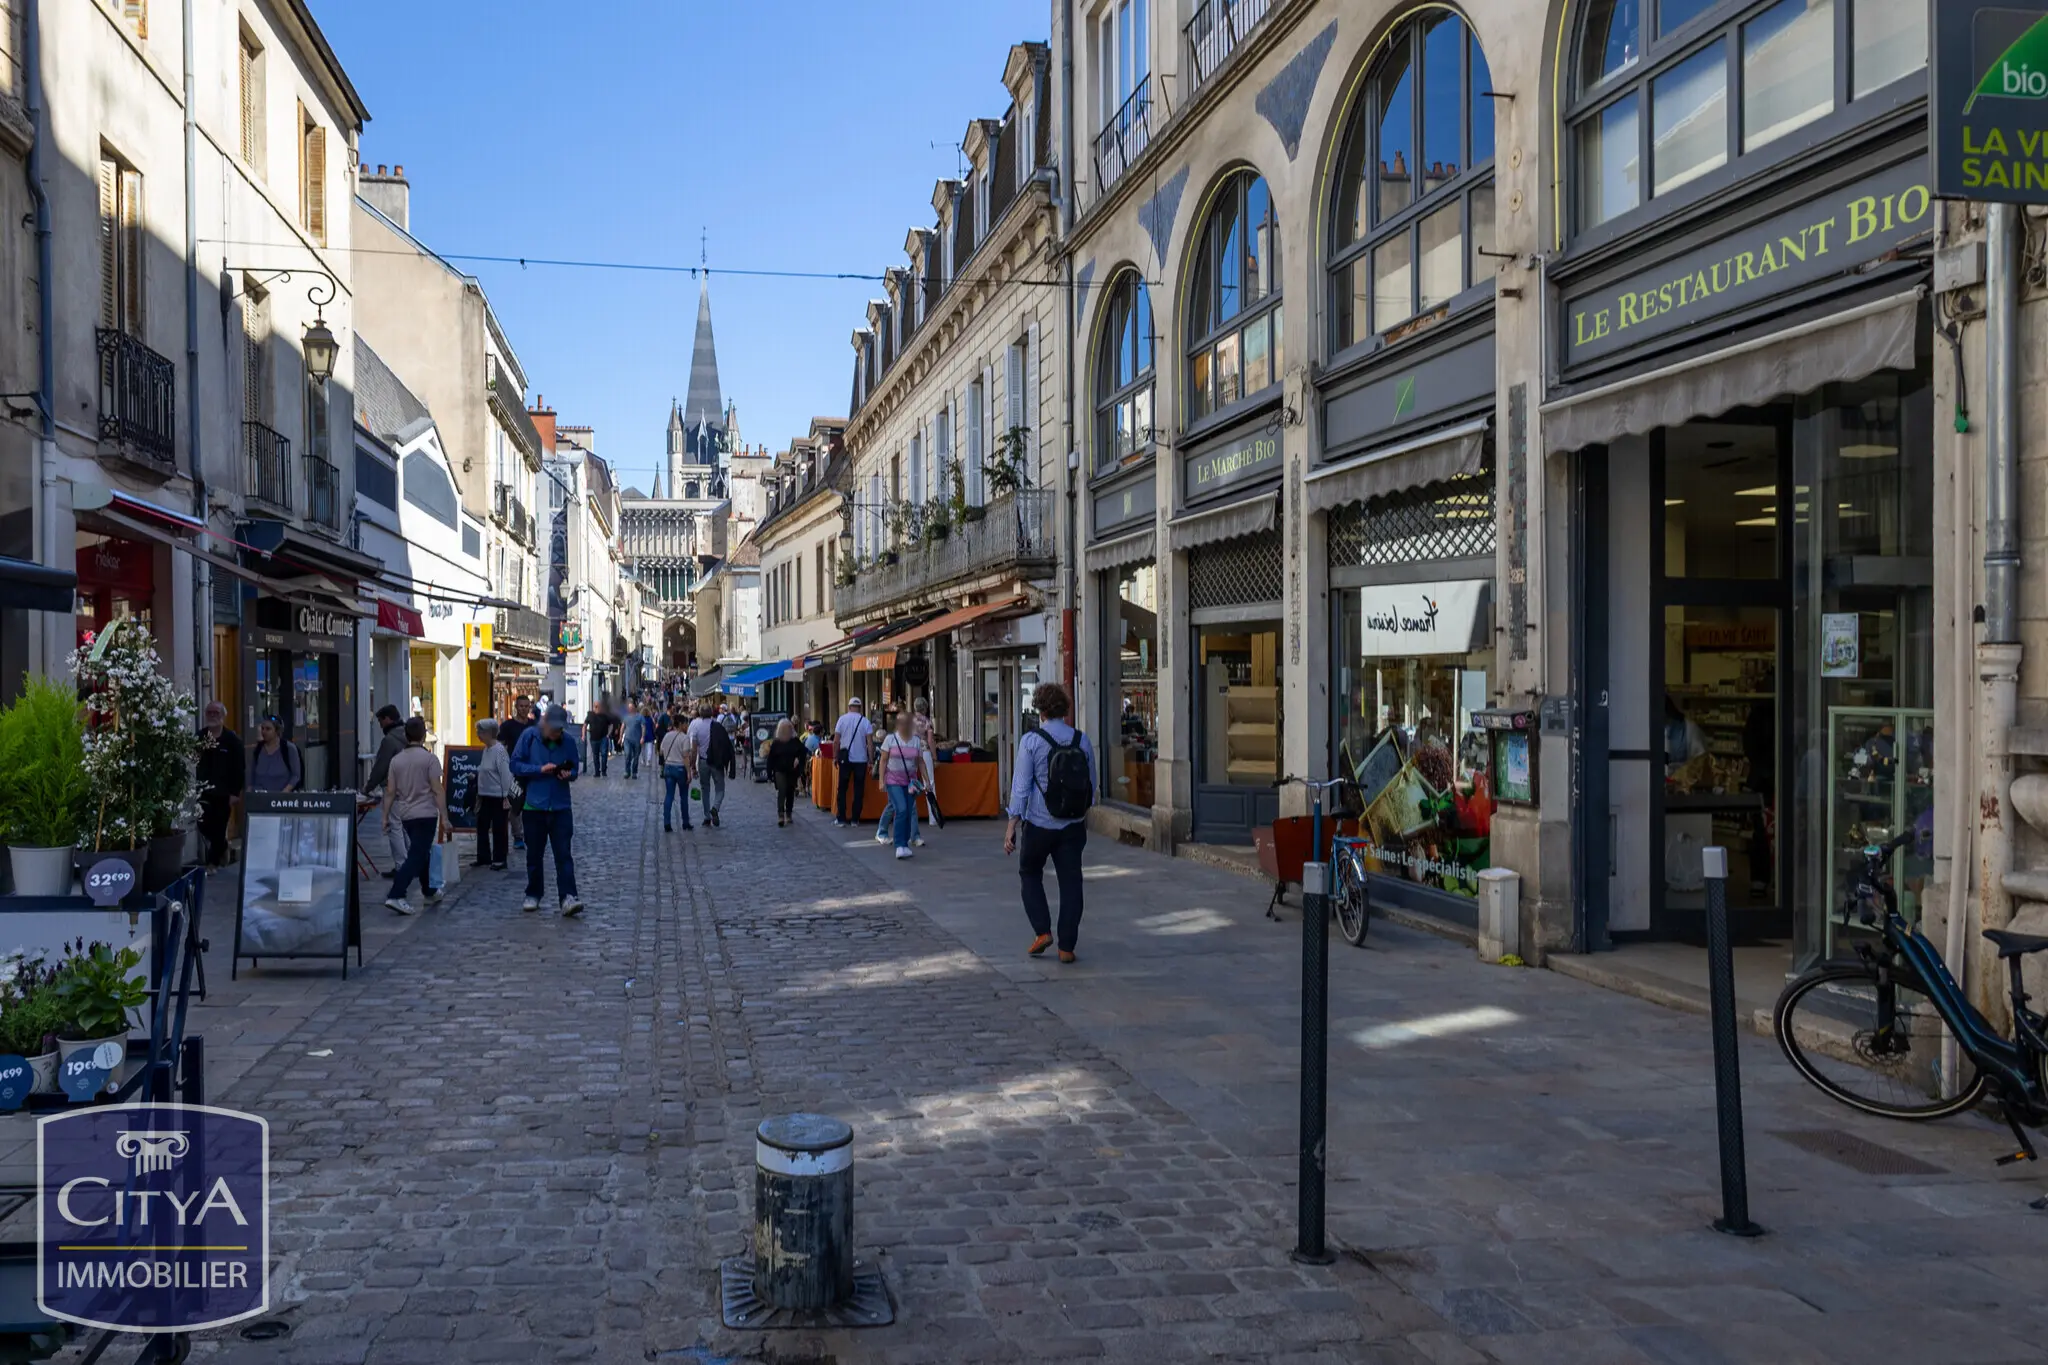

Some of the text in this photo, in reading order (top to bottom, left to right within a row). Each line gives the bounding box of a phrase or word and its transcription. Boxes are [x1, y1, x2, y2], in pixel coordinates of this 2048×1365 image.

[2003, 61, 2047, 95] bio
[1962, 126, 2008, 156] LA
[1617, 217, 1836, 332] RESTAURANT
[1846, 184, 1930, 246] BIO
[1511, 569, 1523, 583] 27
[299, 606, 353, 637] Chalet Comtois
[271, 800, 299, 808] CARRÉ
[1402, 851, 1413, 867] Le
[0, 1067, 23, 1081] €99
[67, 1061, 97, 1076] 19€9
